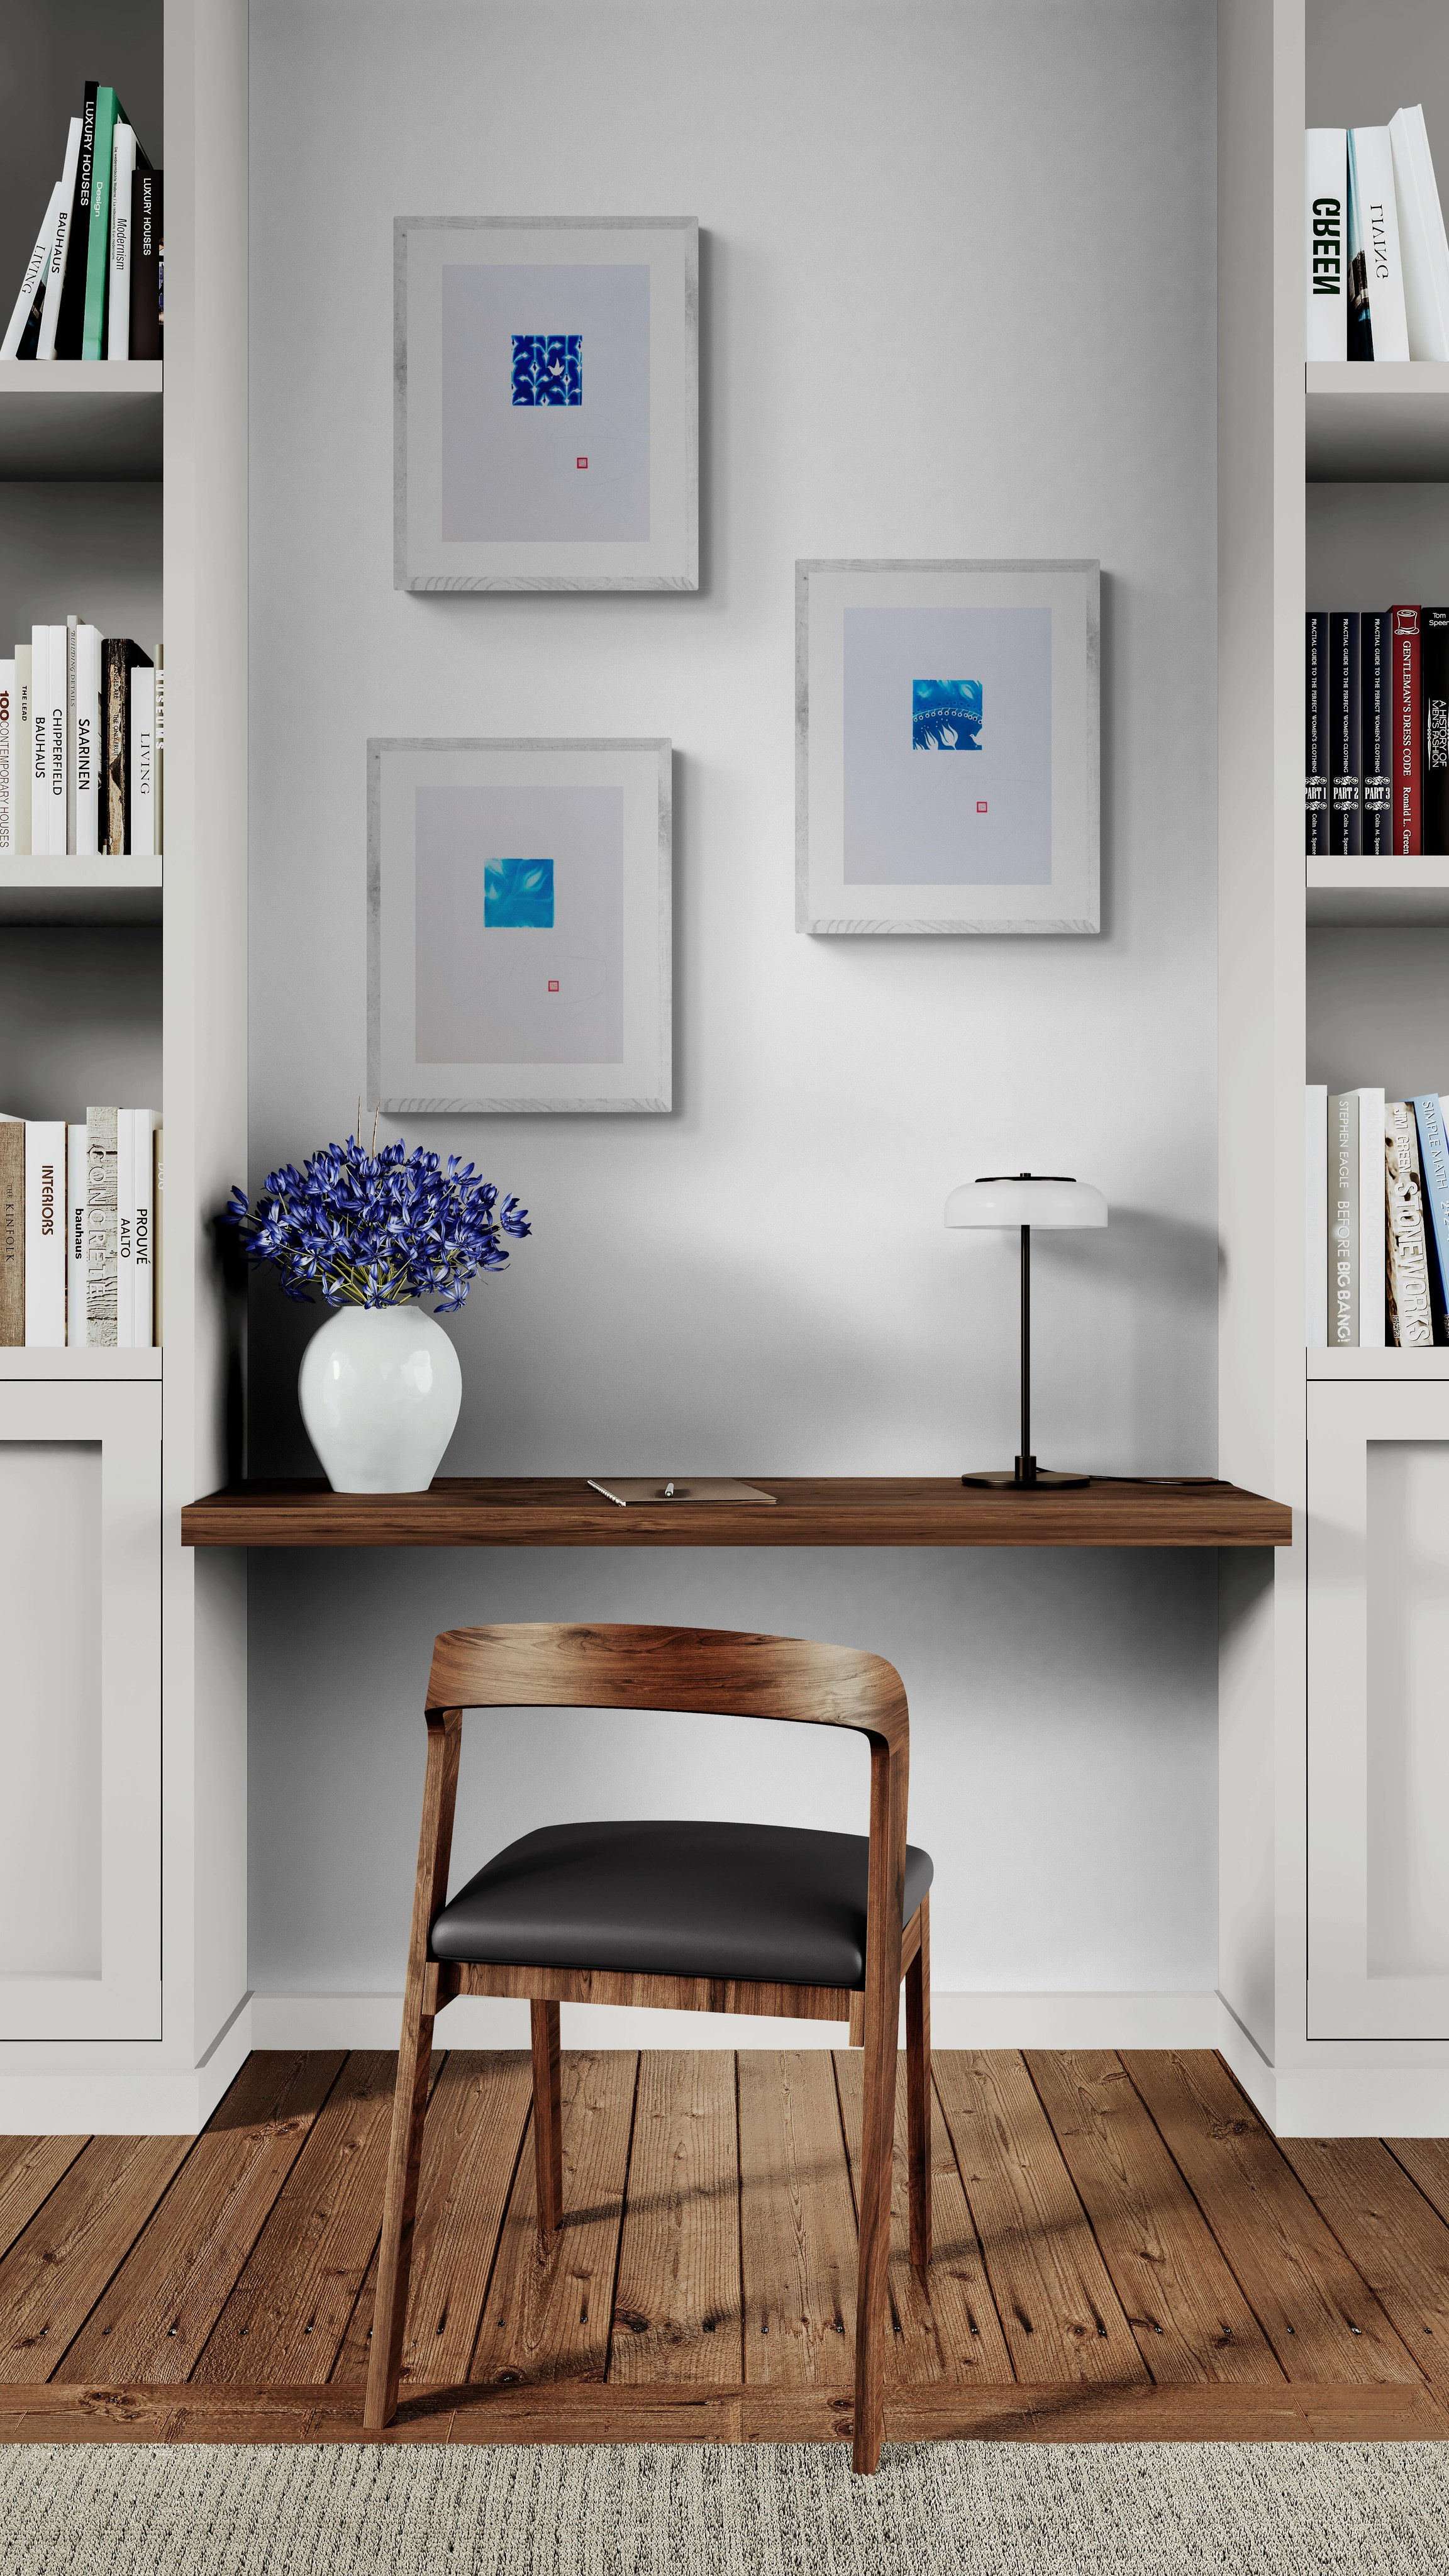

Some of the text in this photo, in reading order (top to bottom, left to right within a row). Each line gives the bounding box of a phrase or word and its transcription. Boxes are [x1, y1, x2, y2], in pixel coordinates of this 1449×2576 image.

[80, 101, 94, 206] LUXURY HOUSES
[22, 245, 46, 294] LIVING
[52, 212, 67, 274] BAUHAUS
[116, 218, 127, 271] Modernism
[1312, 667, 1317, 675] TO
[1343, 667, 1348, 675] TO
[1375, 667, 1380, 675] TO
[156, 669, 164, 750] MUSEUMS
[1402, 640, 1411, 776] GENTLEMAN'S DRESS CODE
[1439, 709, 1447, 751] HISTORY
[36, 717, 45, 779] BAUHAUS
[53, 709, 62, 795] CHIPPERFIELD
[79, 719, 90, 790] SAARINEN
[140, 733, 150, 795] LIVING
[1439, 753, 1447, 767] OF
[1323, 787, 1326, 799] 1
[1333, 787, 1358, 799] PART 2
[1365, 787, 1391, 799] PART 3
[0, 807, 9, 848] HOUSES
[1403, 787, 1411, 855] Ronald L. Green
[1422, 1101, 1440, 1147] SIMPLE
[1430, 1152, 1448, 1190] MATH
[42, 1165, 53, 1235] INTERIORS
[88, 1145, 106, 1295] CONCRETE
[1338, 1101, 1350, 1343] STEPHEN EAGLE BEFORE BIG BANG!
[1394, 1108, 1430, 1343] JIM GREEN STONEWORKS
[6, 1204, 14, 1261] KINFOLK
[75, 1208, 84, 1260] bauhaus
[121, 1218, 130, 1258] AALTO
[136, 1209, 151, 1265] PROUVÉ
